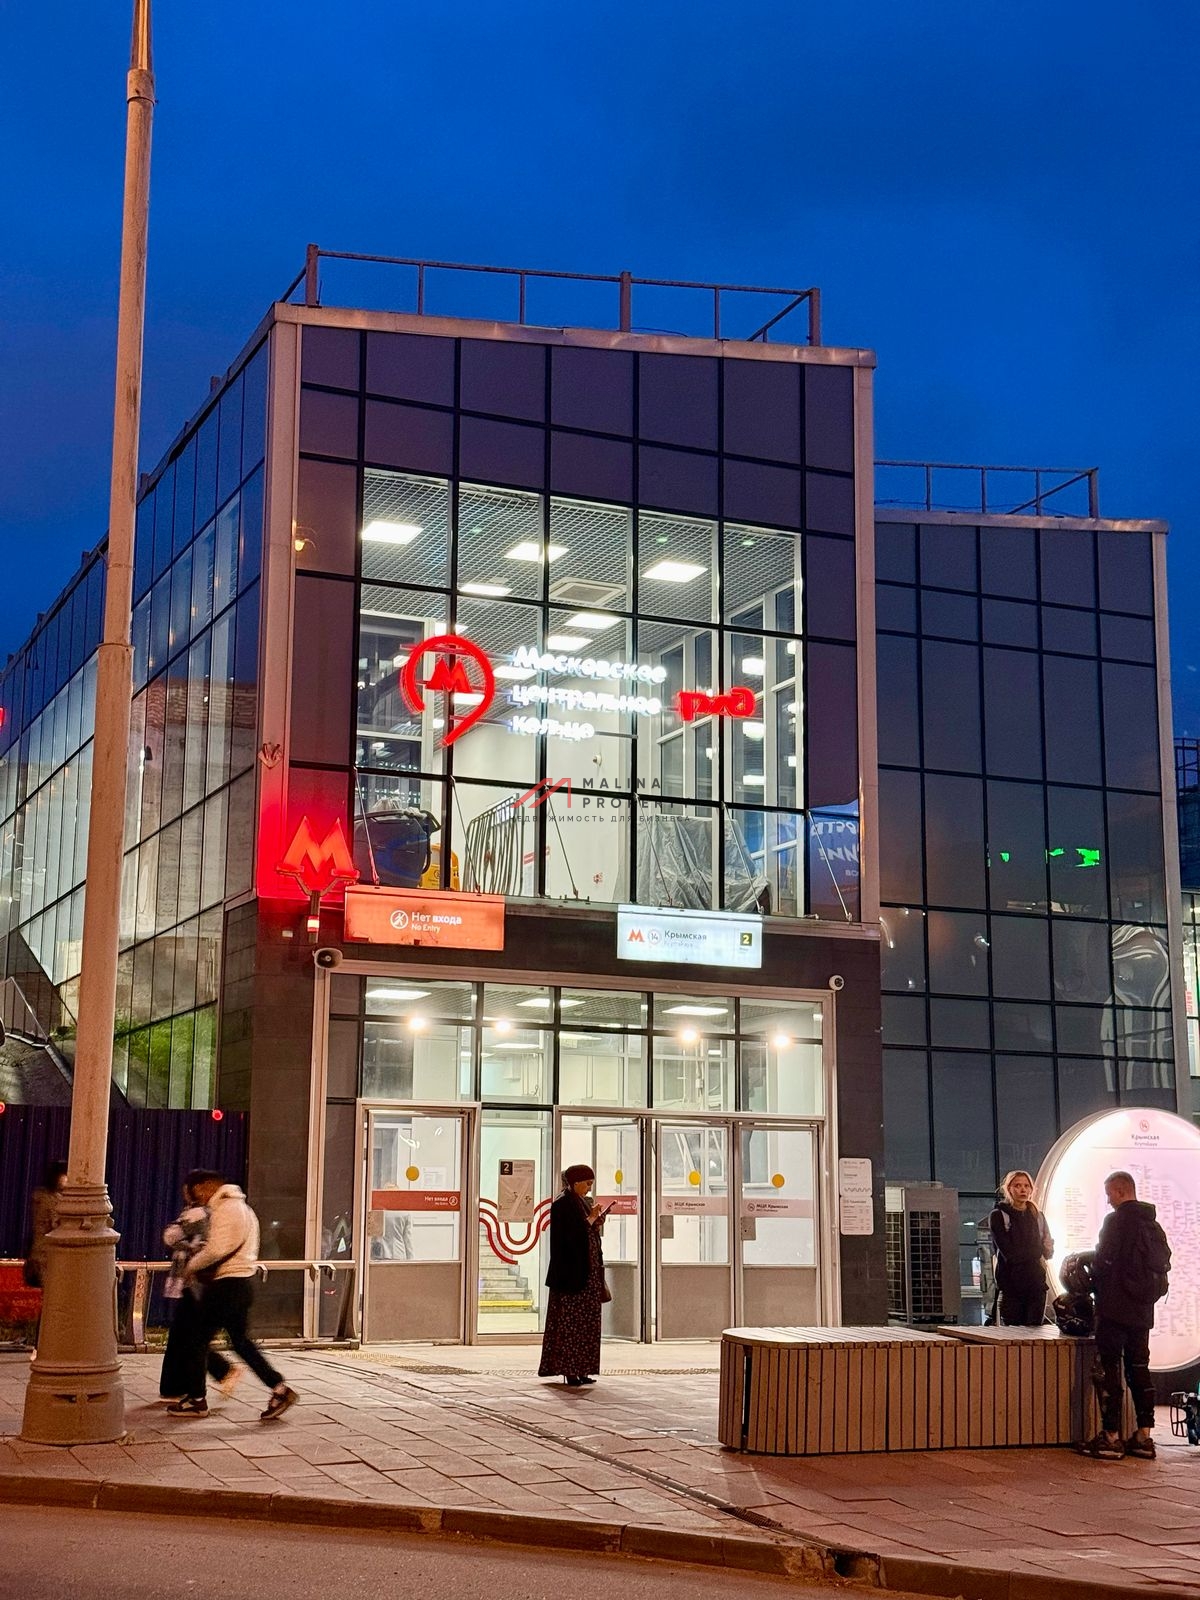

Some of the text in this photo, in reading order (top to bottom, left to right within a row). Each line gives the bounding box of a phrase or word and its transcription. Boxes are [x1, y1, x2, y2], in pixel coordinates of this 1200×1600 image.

[512, 646, 667, 685] Московское
[411, 912, 462, 926] Нет входа
[423, 925, 441, 933] Entry
[664, 930, 708, 941] Крымская
[742, 935, 750, 945] 2
